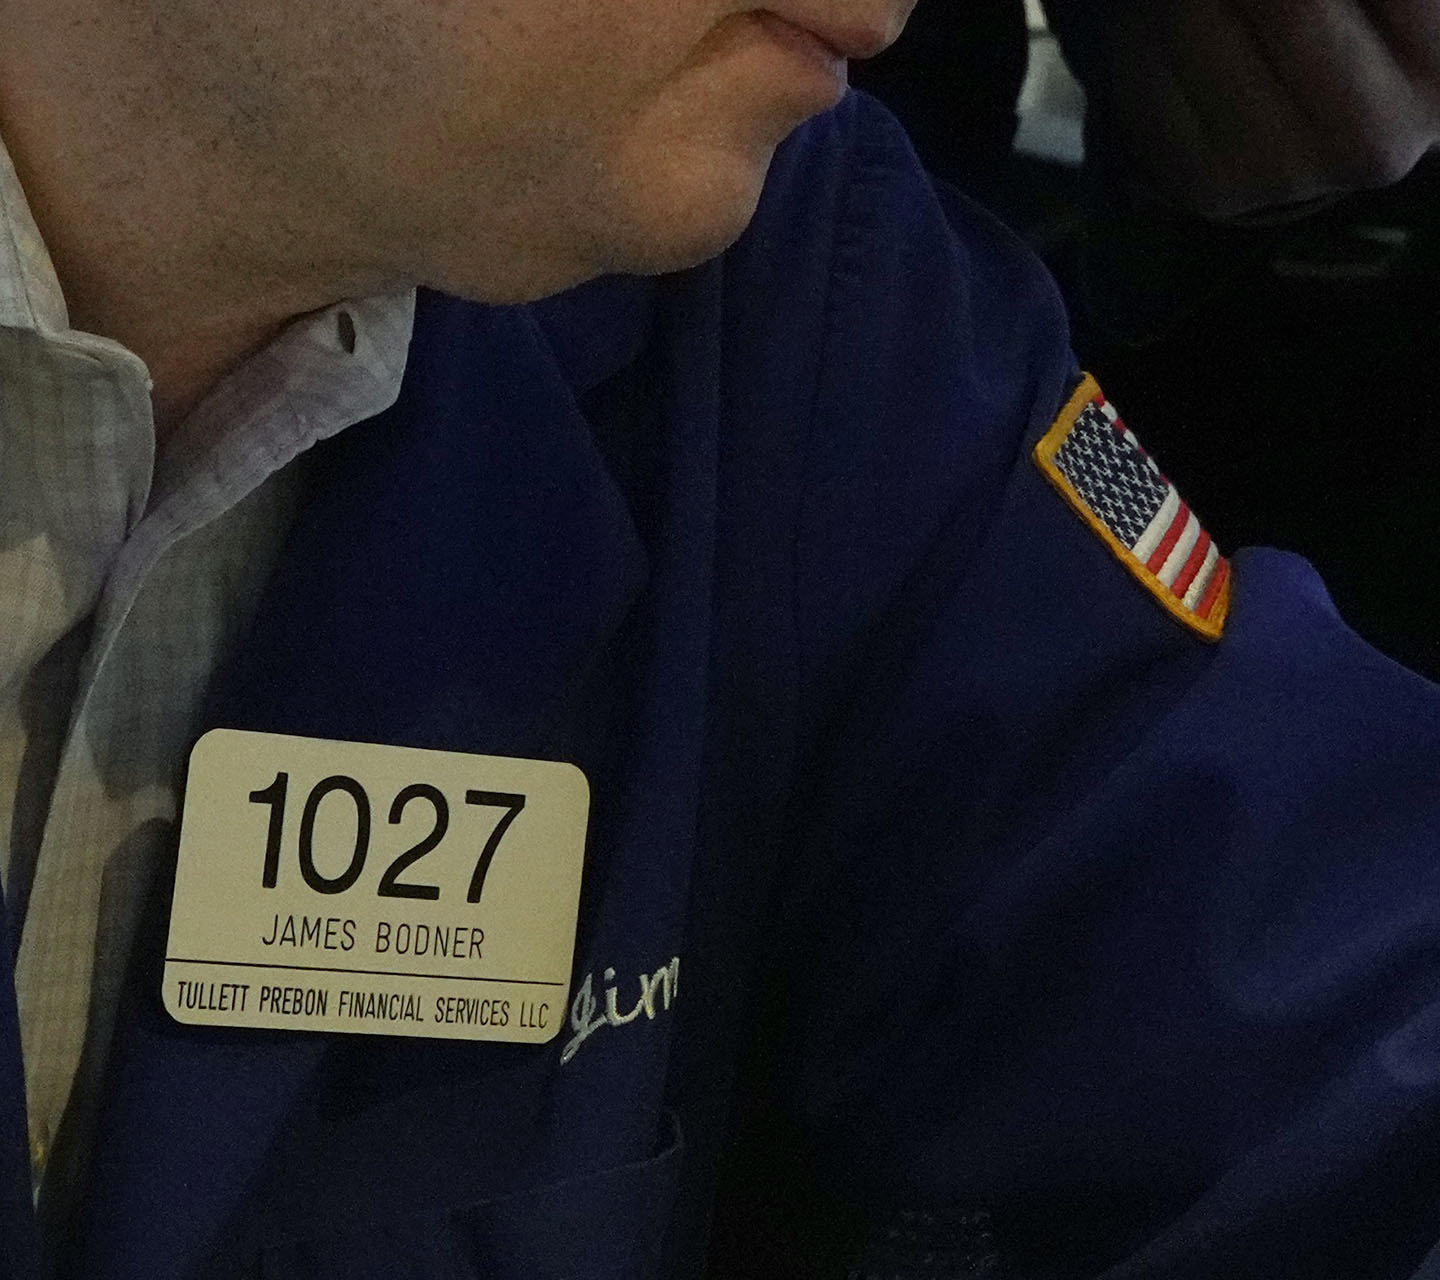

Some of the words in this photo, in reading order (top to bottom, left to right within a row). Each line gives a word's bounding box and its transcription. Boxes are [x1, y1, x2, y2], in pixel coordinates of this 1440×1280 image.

[249, 771, 526, 904] 1027
[262, 914, 357, 953] JAMES
[376, 921, 486, 960] BODNER
[177, 981, 250, 1013] TULLETT
[260, 986, 327, 1017] PREBON
[339, 991, 426, 1023] FINANCIAL
[435, 997, 510, 1028] SERVICES
[519, 1002, 551, 1030] LLC
